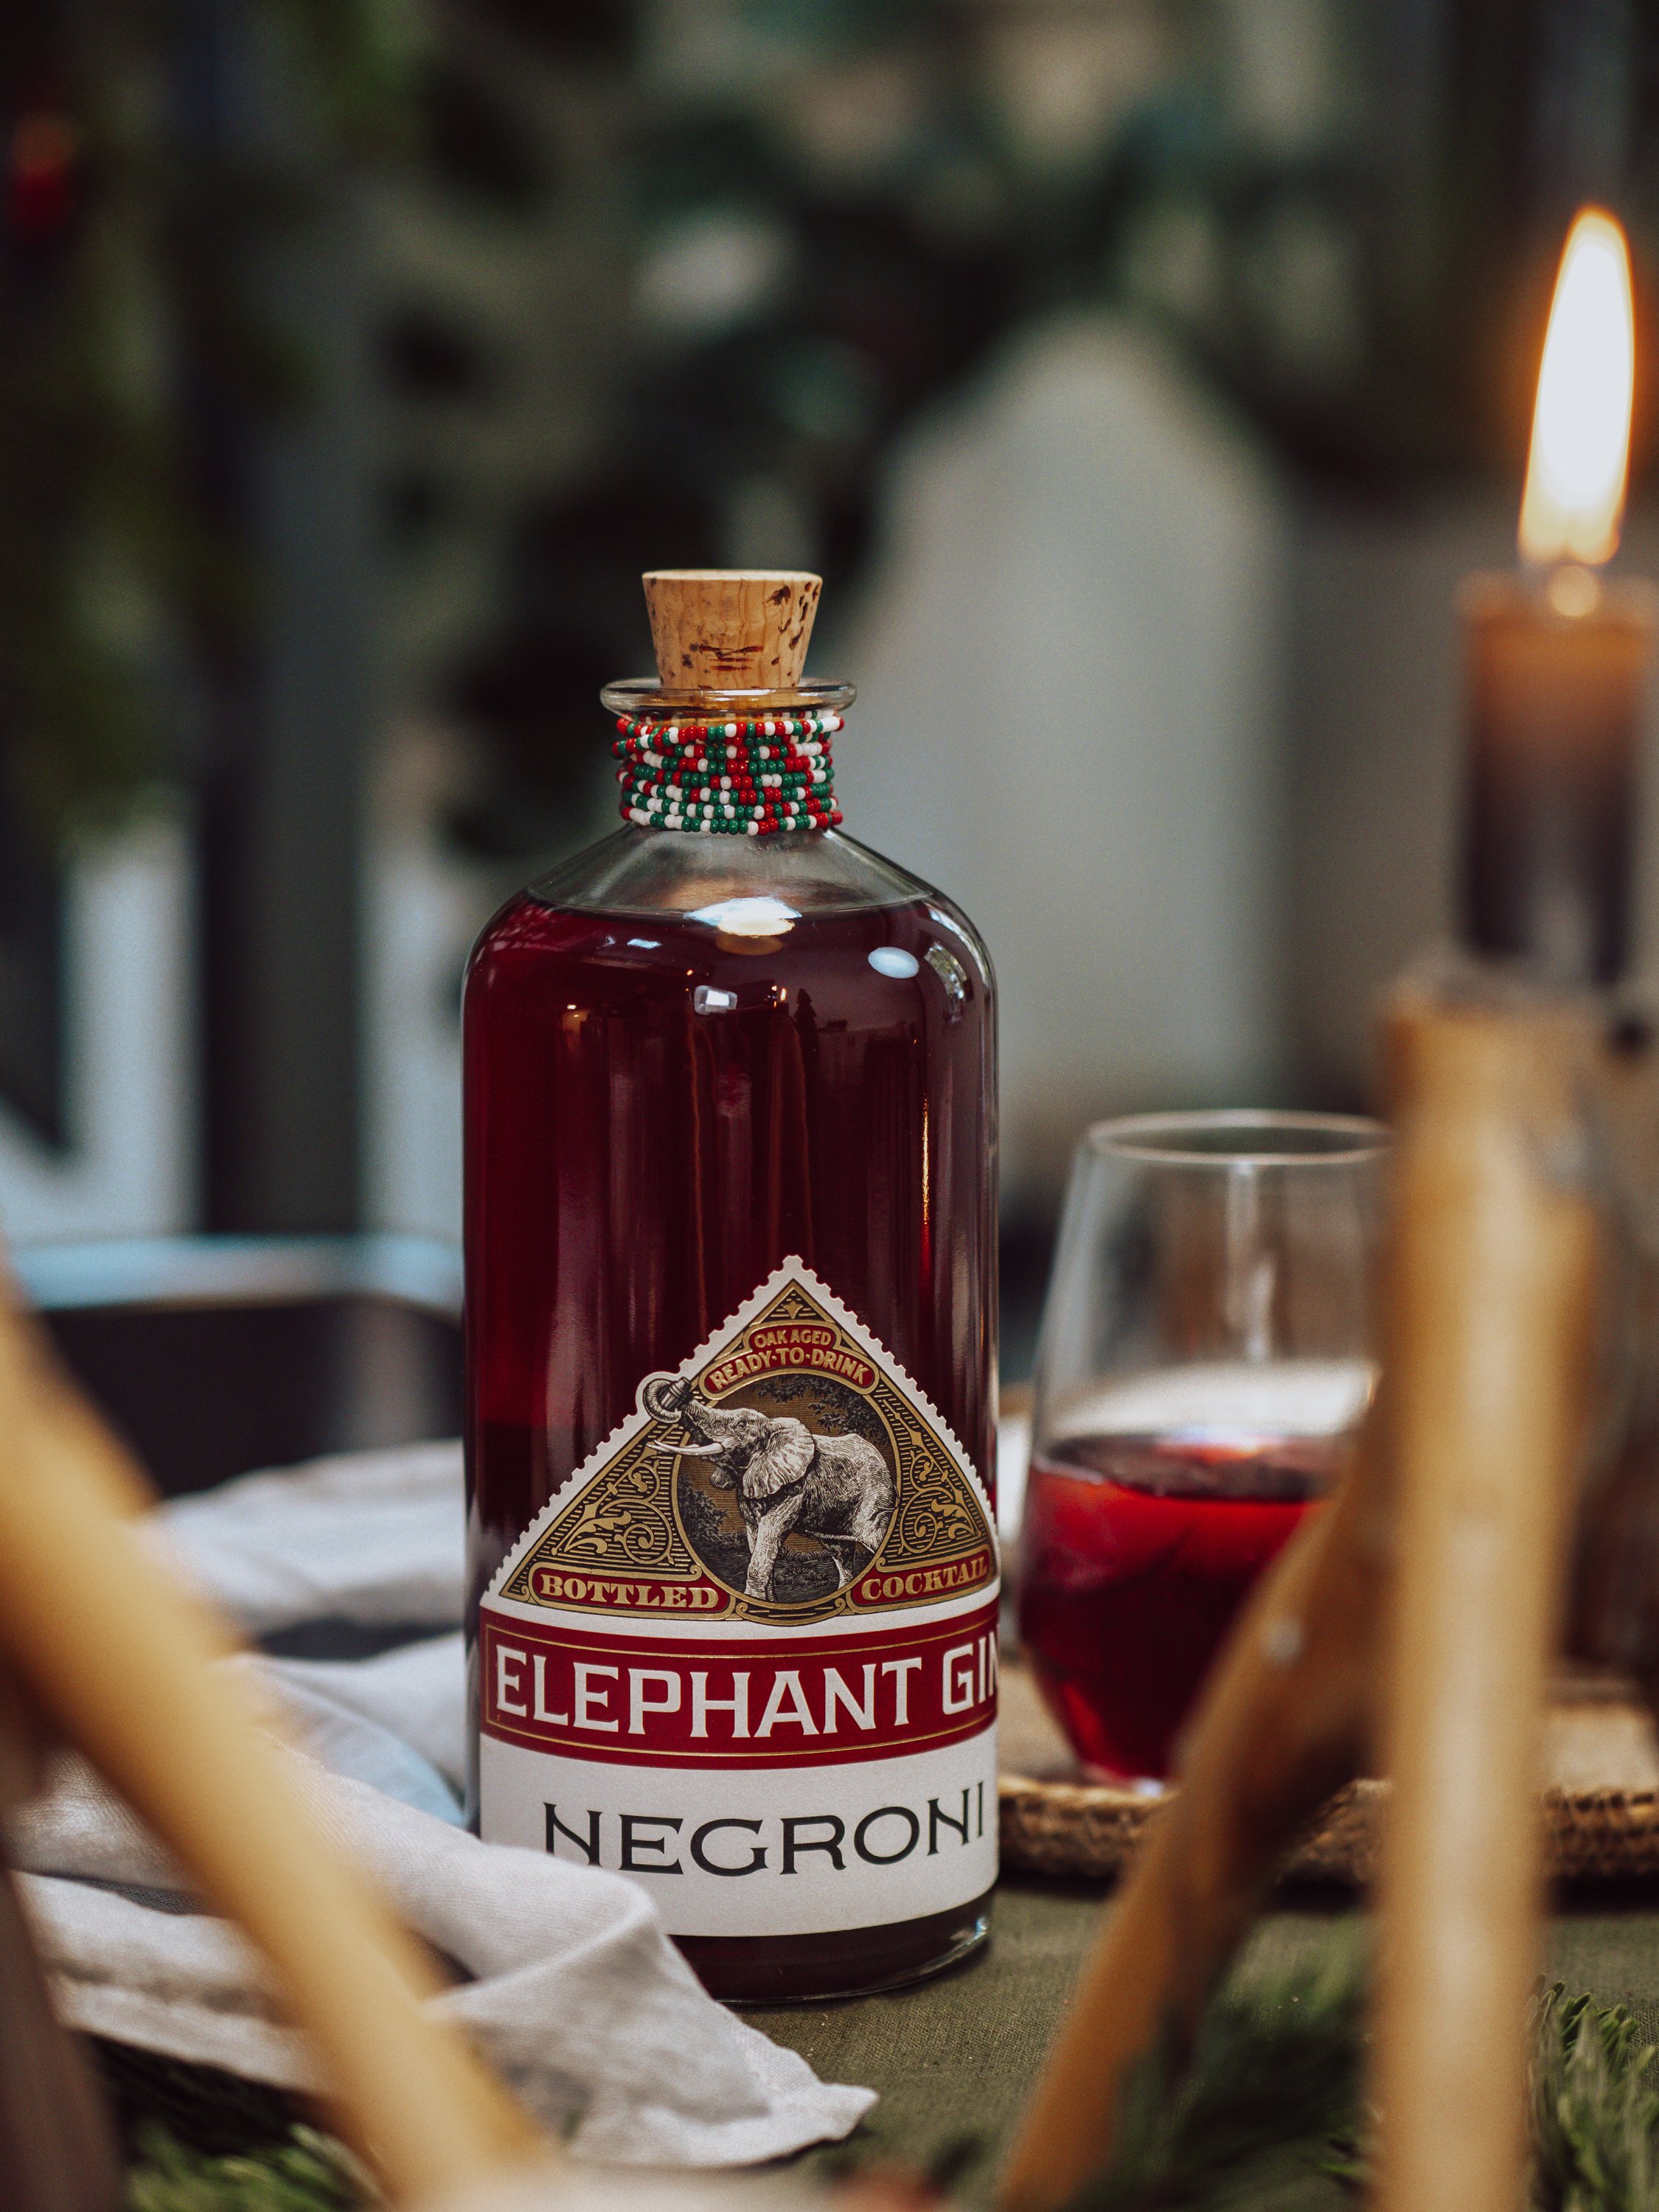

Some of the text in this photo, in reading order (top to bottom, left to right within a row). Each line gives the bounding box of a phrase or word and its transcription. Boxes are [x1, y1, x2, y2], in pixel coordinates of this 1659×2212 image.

[754, 1329, 831, 1348] OAK AGED
[539, 1573, 720, 1610] BOTTLED
[861, 1557, 987, 1601] COCKTAIL
[495, 1624, 1000, 1738] ELEPHANT GIN
[543, 1781, 984, 1877] NEGRONI
